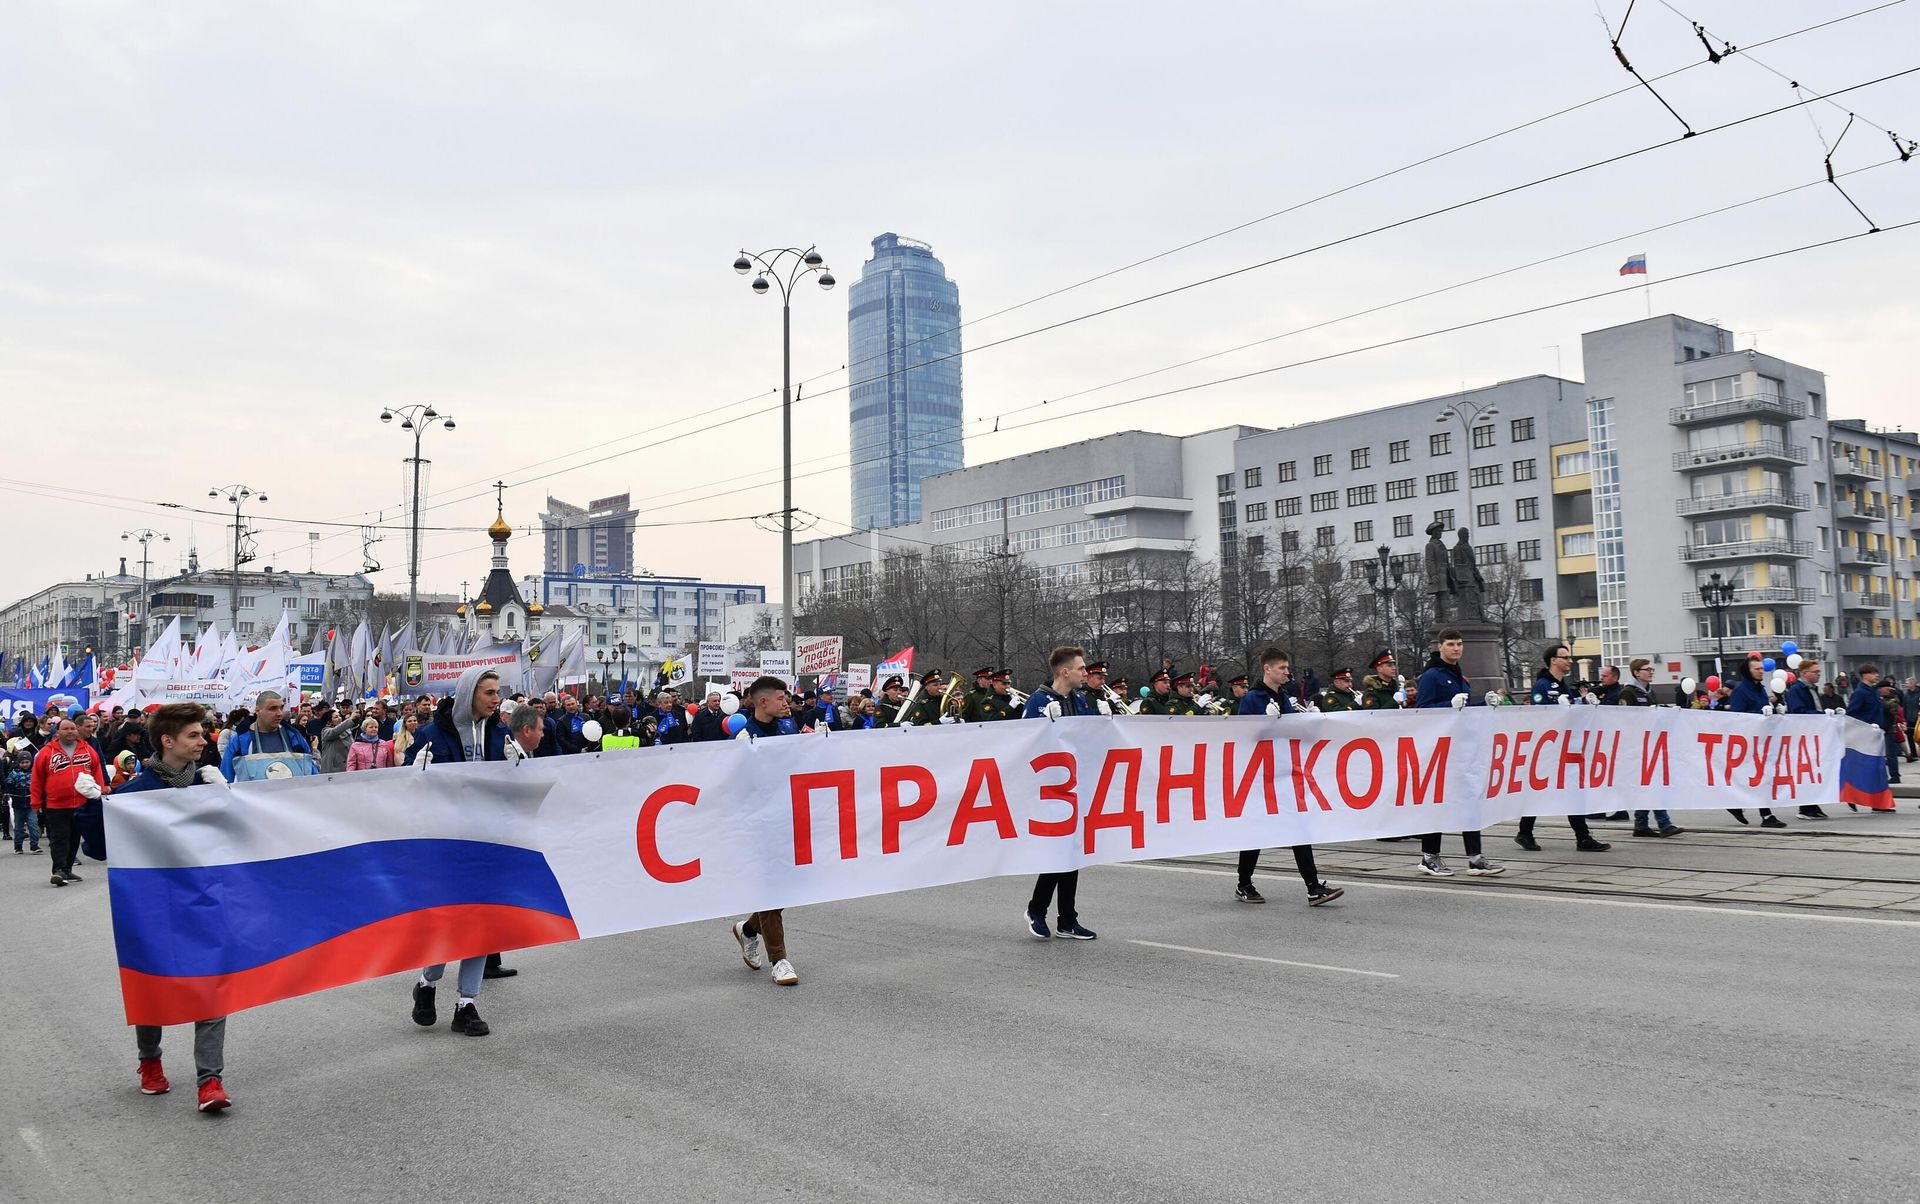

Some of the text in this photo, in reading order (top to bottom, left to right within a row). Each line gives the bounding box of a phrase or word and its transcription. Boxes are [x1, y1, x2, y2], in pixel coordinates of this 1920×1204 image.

[797, 636, 839, 657] Защитим
[804, 647, 835, 663] права
[800, 648, 841, 673] человека!
[427, 671, 462, 681] ПРОФСОЮ
[636, 729, 1822, 884] С ПРАЗДНИКОМ ВЕСНЫ И ТРУДА!
